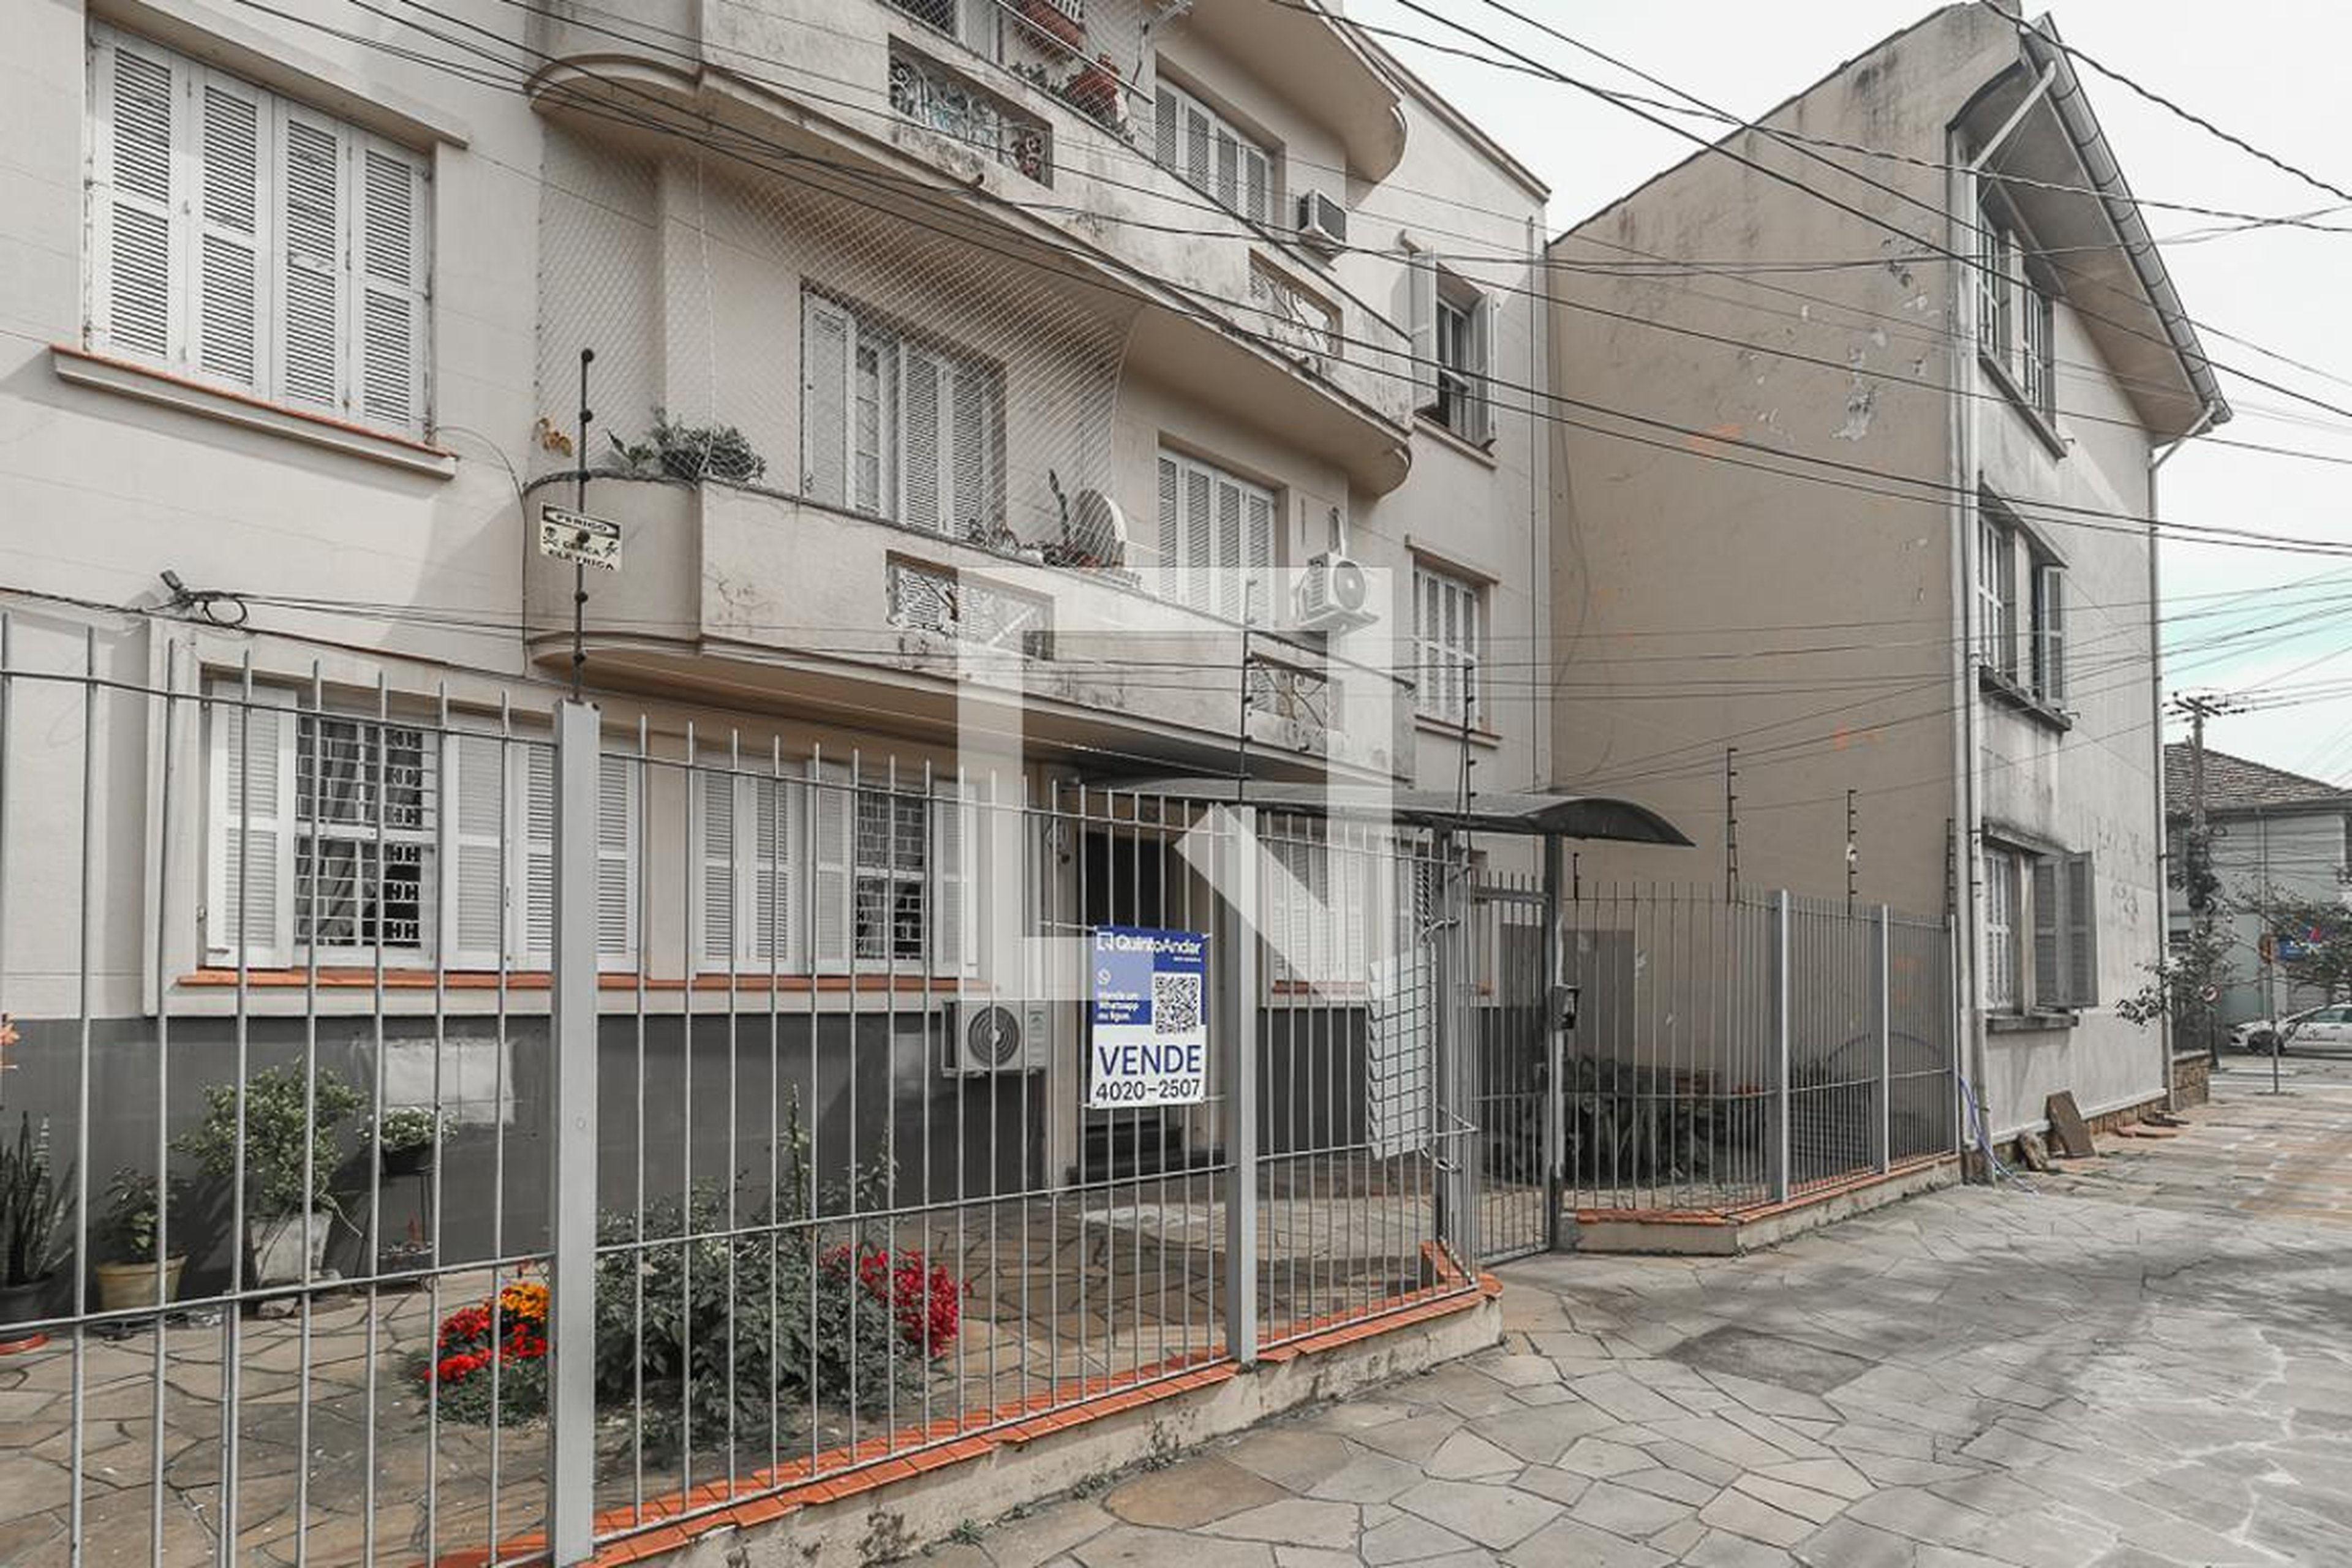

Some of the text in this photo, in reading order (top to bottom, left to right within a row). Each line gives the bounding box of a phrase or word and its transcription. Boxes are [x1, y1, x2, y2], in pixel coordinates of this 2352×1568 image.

[556, 514, 608, 532] PERIGO
[1115, 935, 1202, 954] QuintoAndar
[1099, 1045, 1201, 1076] VENDE
[1096, 1079, 1200, 1101] 4020-2507
